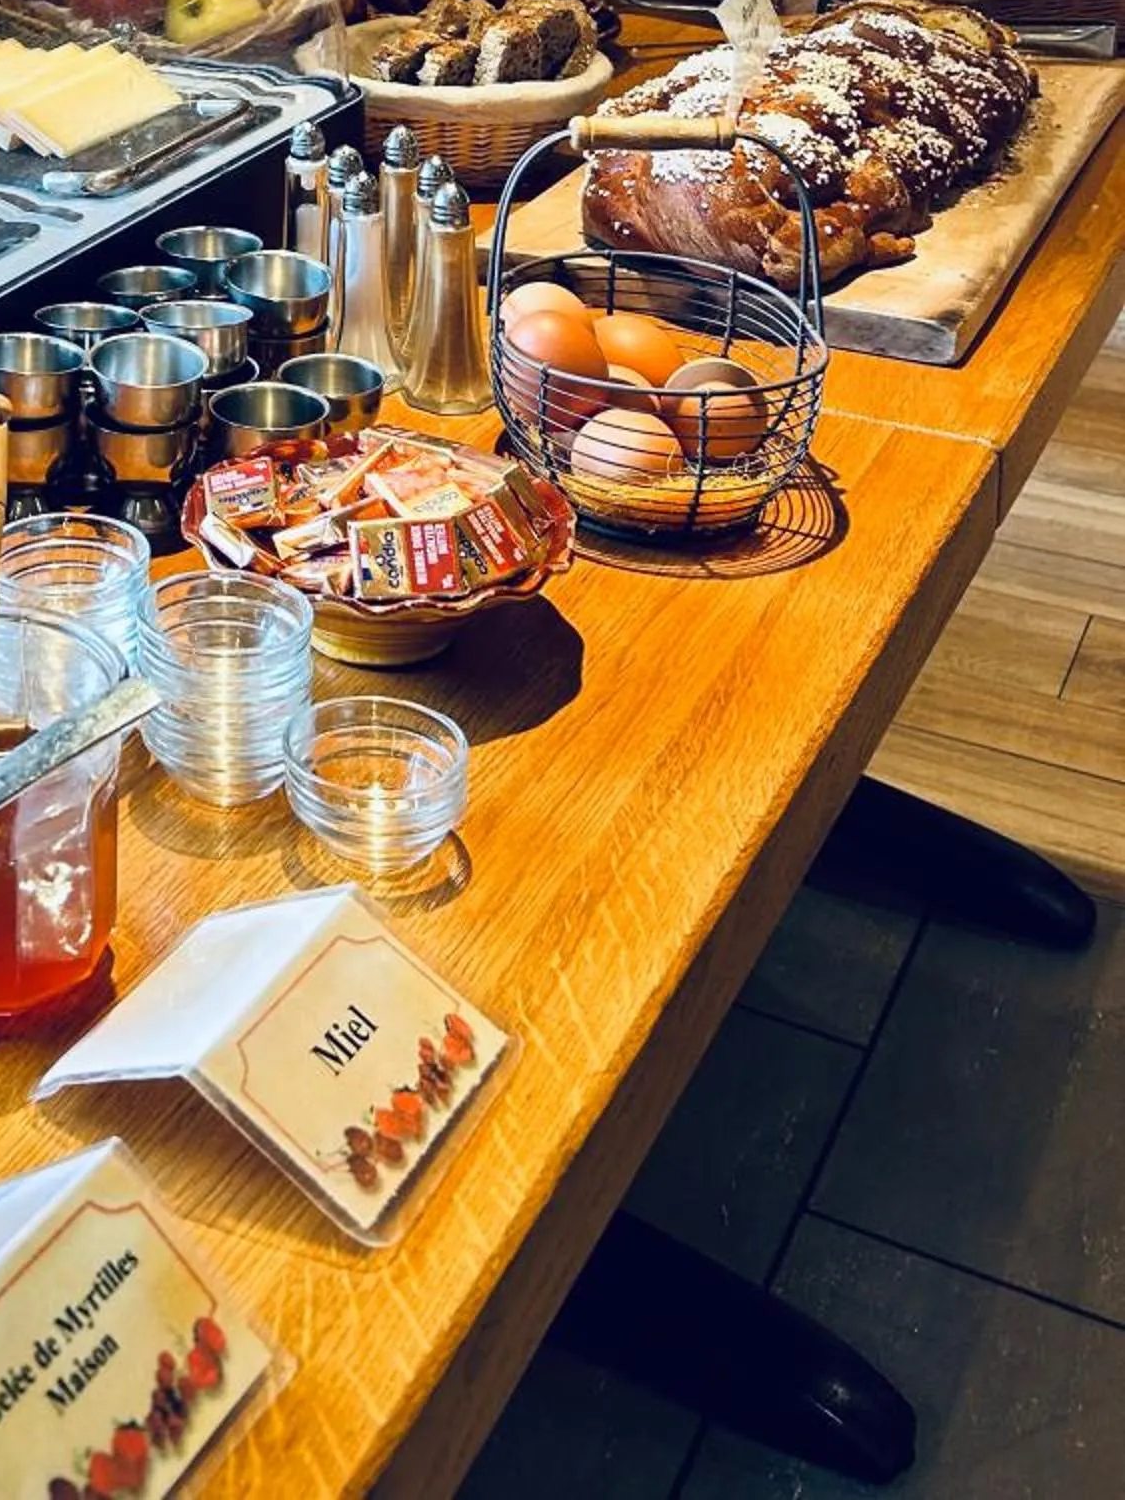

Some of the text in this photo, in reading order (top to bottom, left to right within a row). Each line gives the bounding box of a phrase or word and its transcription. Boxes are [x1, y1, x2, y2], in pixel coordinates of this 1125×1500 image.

[382, 531, 400, 588] candia
[309, 1004, 379, 1076] Miel
[33, 1338, 61, 1370] de
[54, 1249, 139, 1344] Myrtilles
[45, 1334, 120, 1416] Maison
